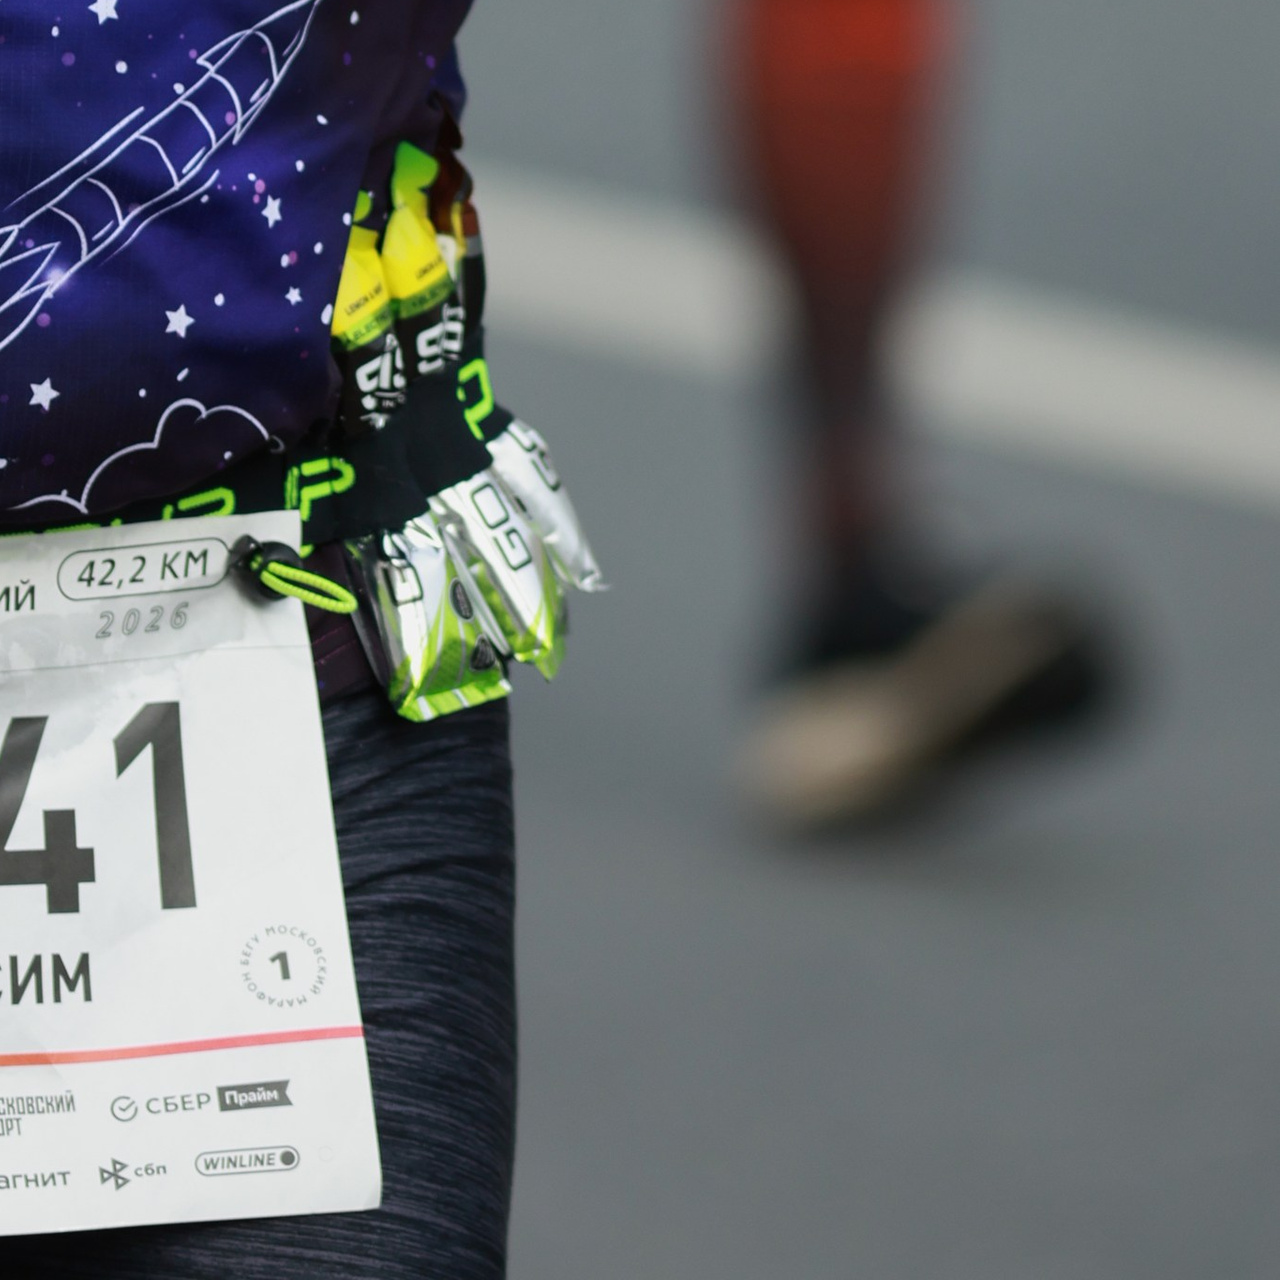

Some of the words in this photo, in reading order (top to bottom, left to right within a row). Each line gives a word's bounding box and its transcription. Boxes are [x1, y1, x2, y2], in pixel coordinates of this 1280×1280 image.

[76, 555, 148, 590] 42,2
[160, 548, 209, 581] КМ
[95, 602, 190, 640] 2026
[269, 950, 291, 981] 1
[146, 1092, 212, 1115] СБЕР
[224, 1087, 280, 1107] Прайм
[134, 1162, 168, 1178] сбп
[203, 1152, 276, 1171] WINLINE
